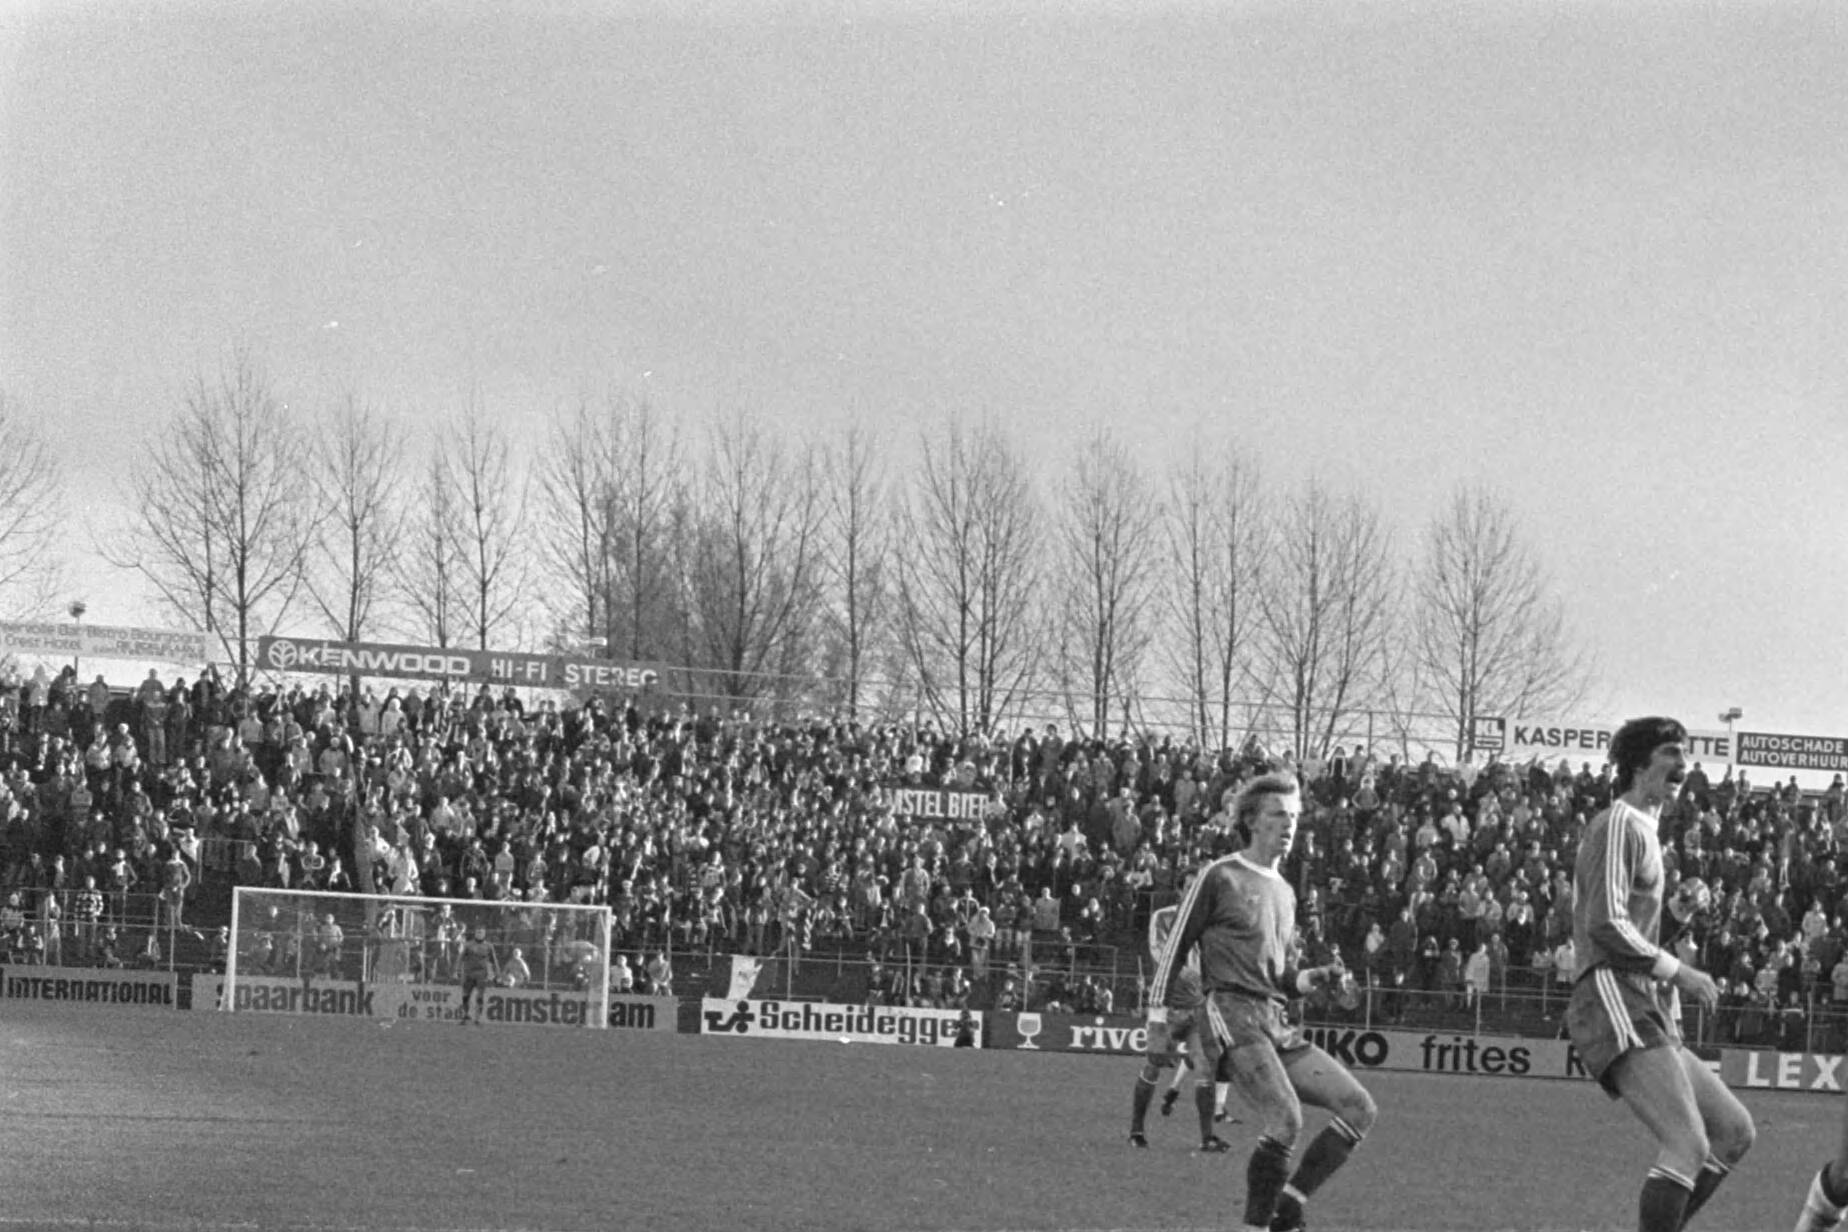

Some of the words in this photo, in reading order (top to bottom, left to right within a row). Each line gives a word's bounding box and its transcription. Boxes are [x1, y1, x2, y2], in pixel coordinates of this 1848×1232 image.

[44, 636, 81, 651] Hotel
[298, 645, 470, 675] KENWOOD
[491, 658, 547, 681] HI-FI
[1514, 726, 1611, 749] KASPER
[1741, 736, 1844, 753] AUTOSCHADE
[7, 977, 173, 1005] INTERNATIONAL
[411, 988, 451, 1002] voor
[398, 1001, 417, 1018] de
[760, 1001, 968, 1045] Scheidegge
[1419, 1035, 1530, 1074] frites
